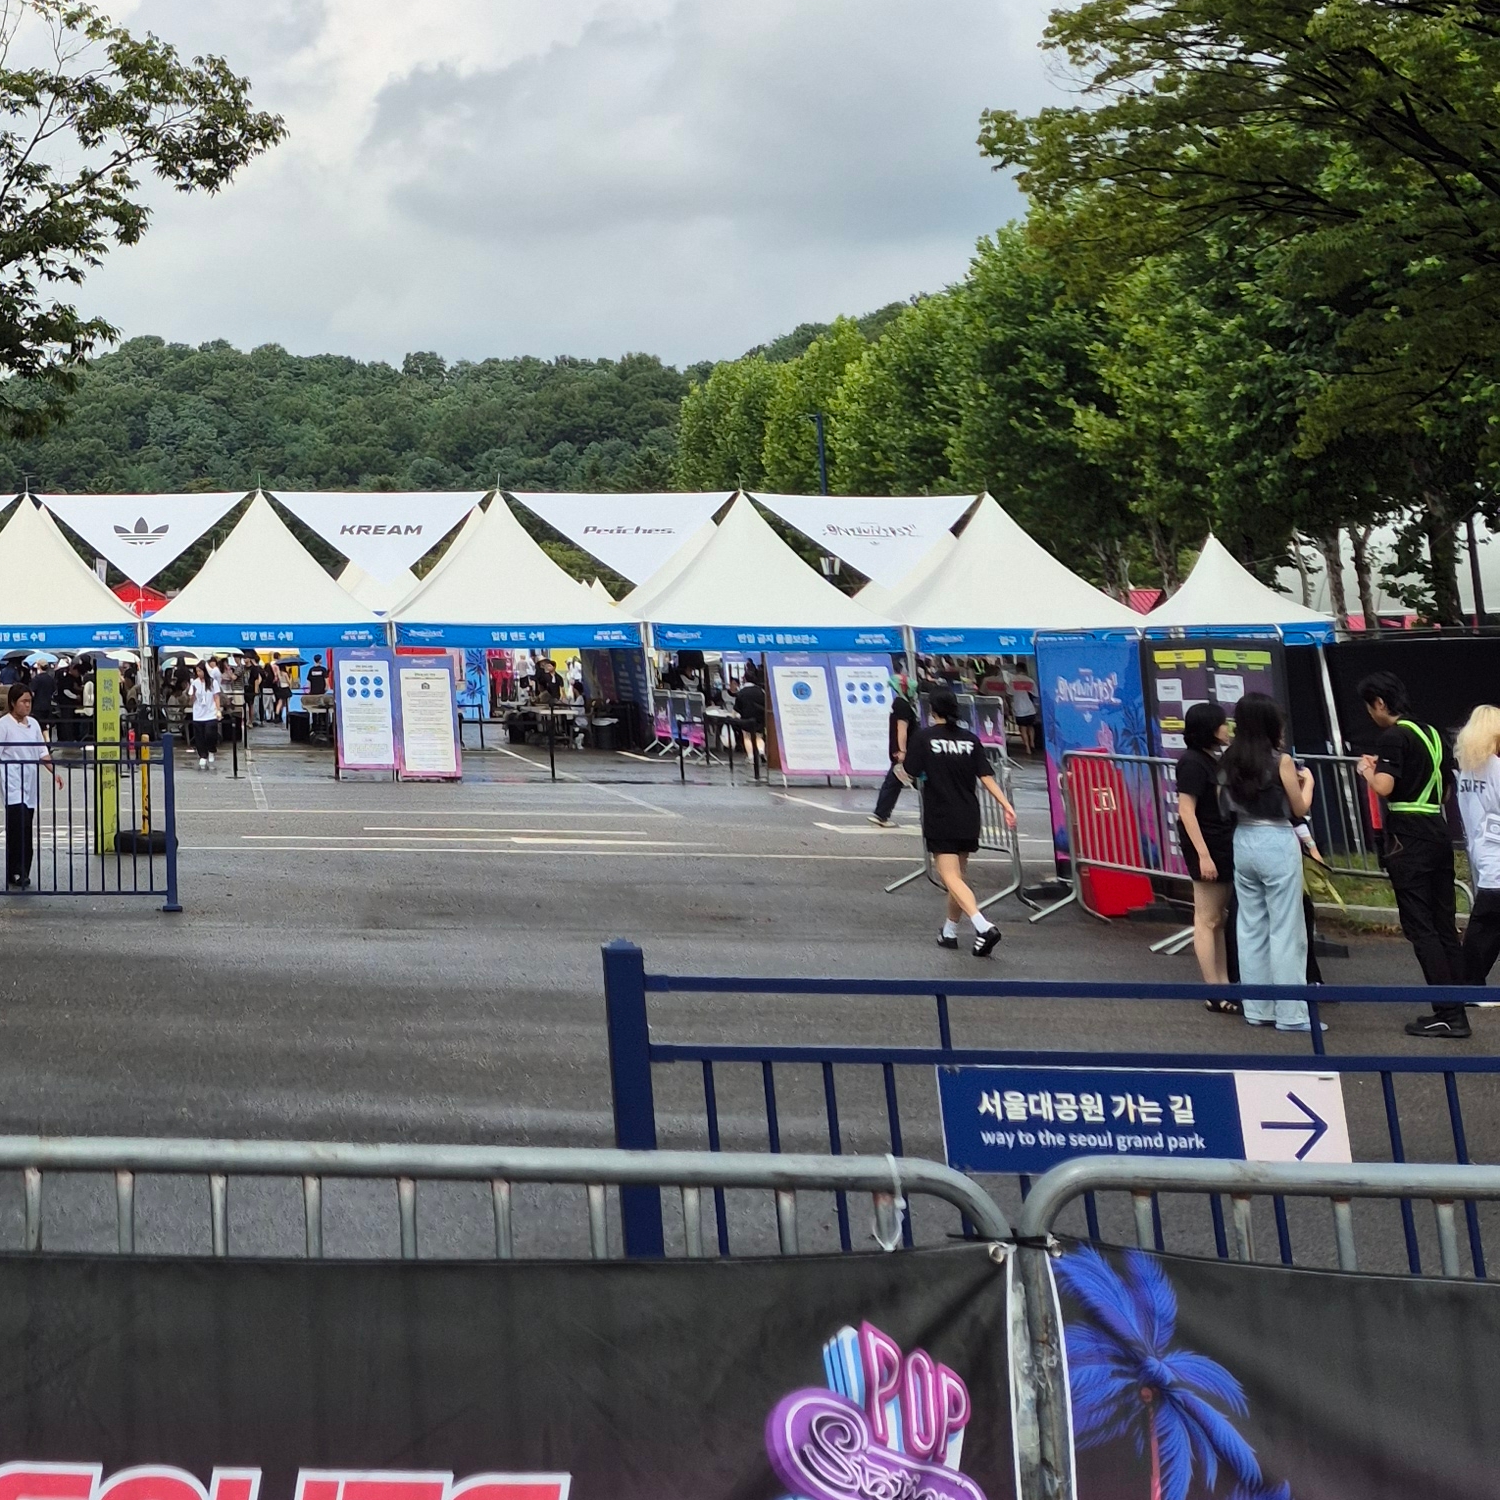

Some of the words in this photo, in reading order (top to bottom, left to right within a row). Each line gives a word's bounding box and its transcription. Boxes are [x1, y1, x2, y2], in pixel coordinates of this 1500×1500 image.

[340, 525, 423, 535] KREAM
[930, 739, 974, 755] STAFF
[977, 1090, 1104, 1123] 서울대공원
[1111, 1091, 1163, 1124] 가는
[1168, 1093, 1196, 1125] 길
[980, 1131, 1015, 1149] way
[1018, 1130, 1035, 1146] to
[1038, 1129, 1066, 1146] the
[1068, 1129, 1113, 1148] seoul
[1116, 1131, 1165, 1151] grand
[1167, 1132, 1207, 1153] park
[859, 1319, 971, 1466] POP
